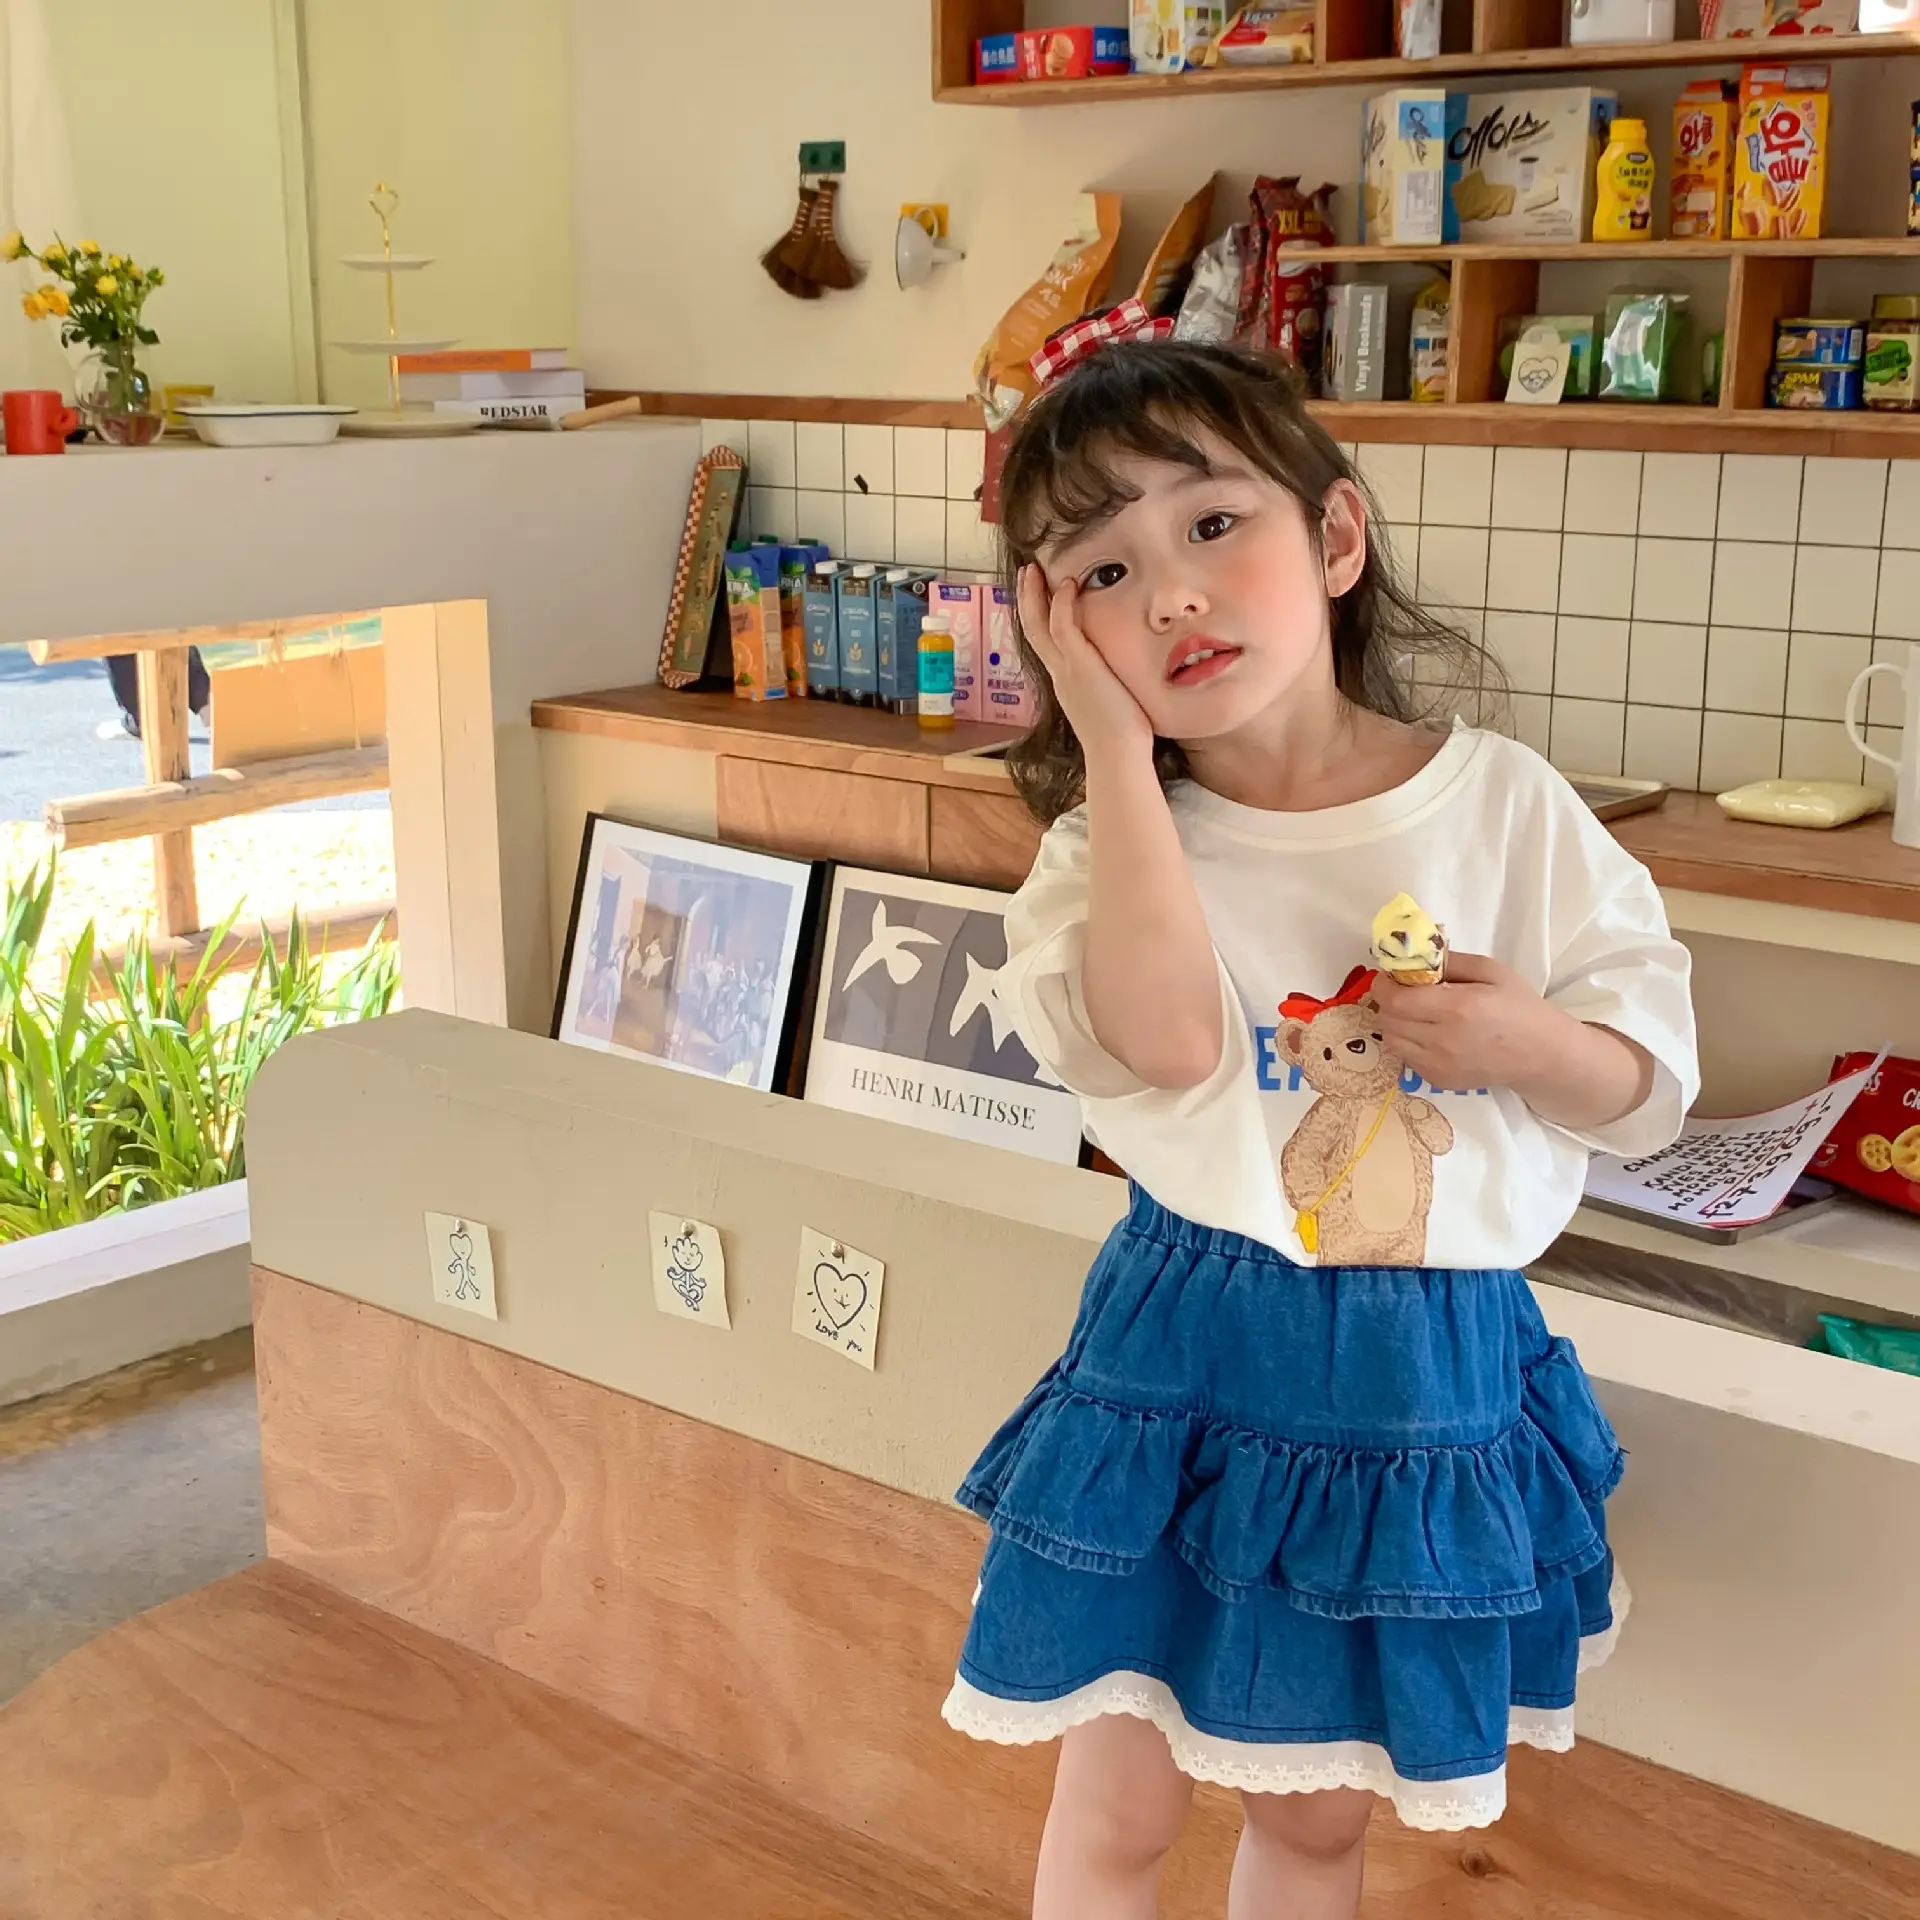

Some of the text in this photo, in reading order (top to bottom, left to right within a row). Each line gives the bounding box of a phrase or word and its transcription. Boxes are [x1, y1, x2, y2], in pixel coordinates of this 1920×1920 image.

[1448, 105, 1551, 168] 에이스
[1355, 294, 1372, 392] Vinyl Bookends
[1785, 371, 1821, 385] SPAM
[851, 1068, 1037, 1131] HENRI MATISSE
[1623, 1133, 1706, 1172] CHAGALL
[1641, 1135, 1740, 1189] KANDINSKY
[1724, 1125, 1794, 1184] PICASSO
[1657, 1168, 1704, 1192] YVES
[1668, 1168, 1738, 1211] MOHOLY
[816, 1319, 839, 1340] Love
